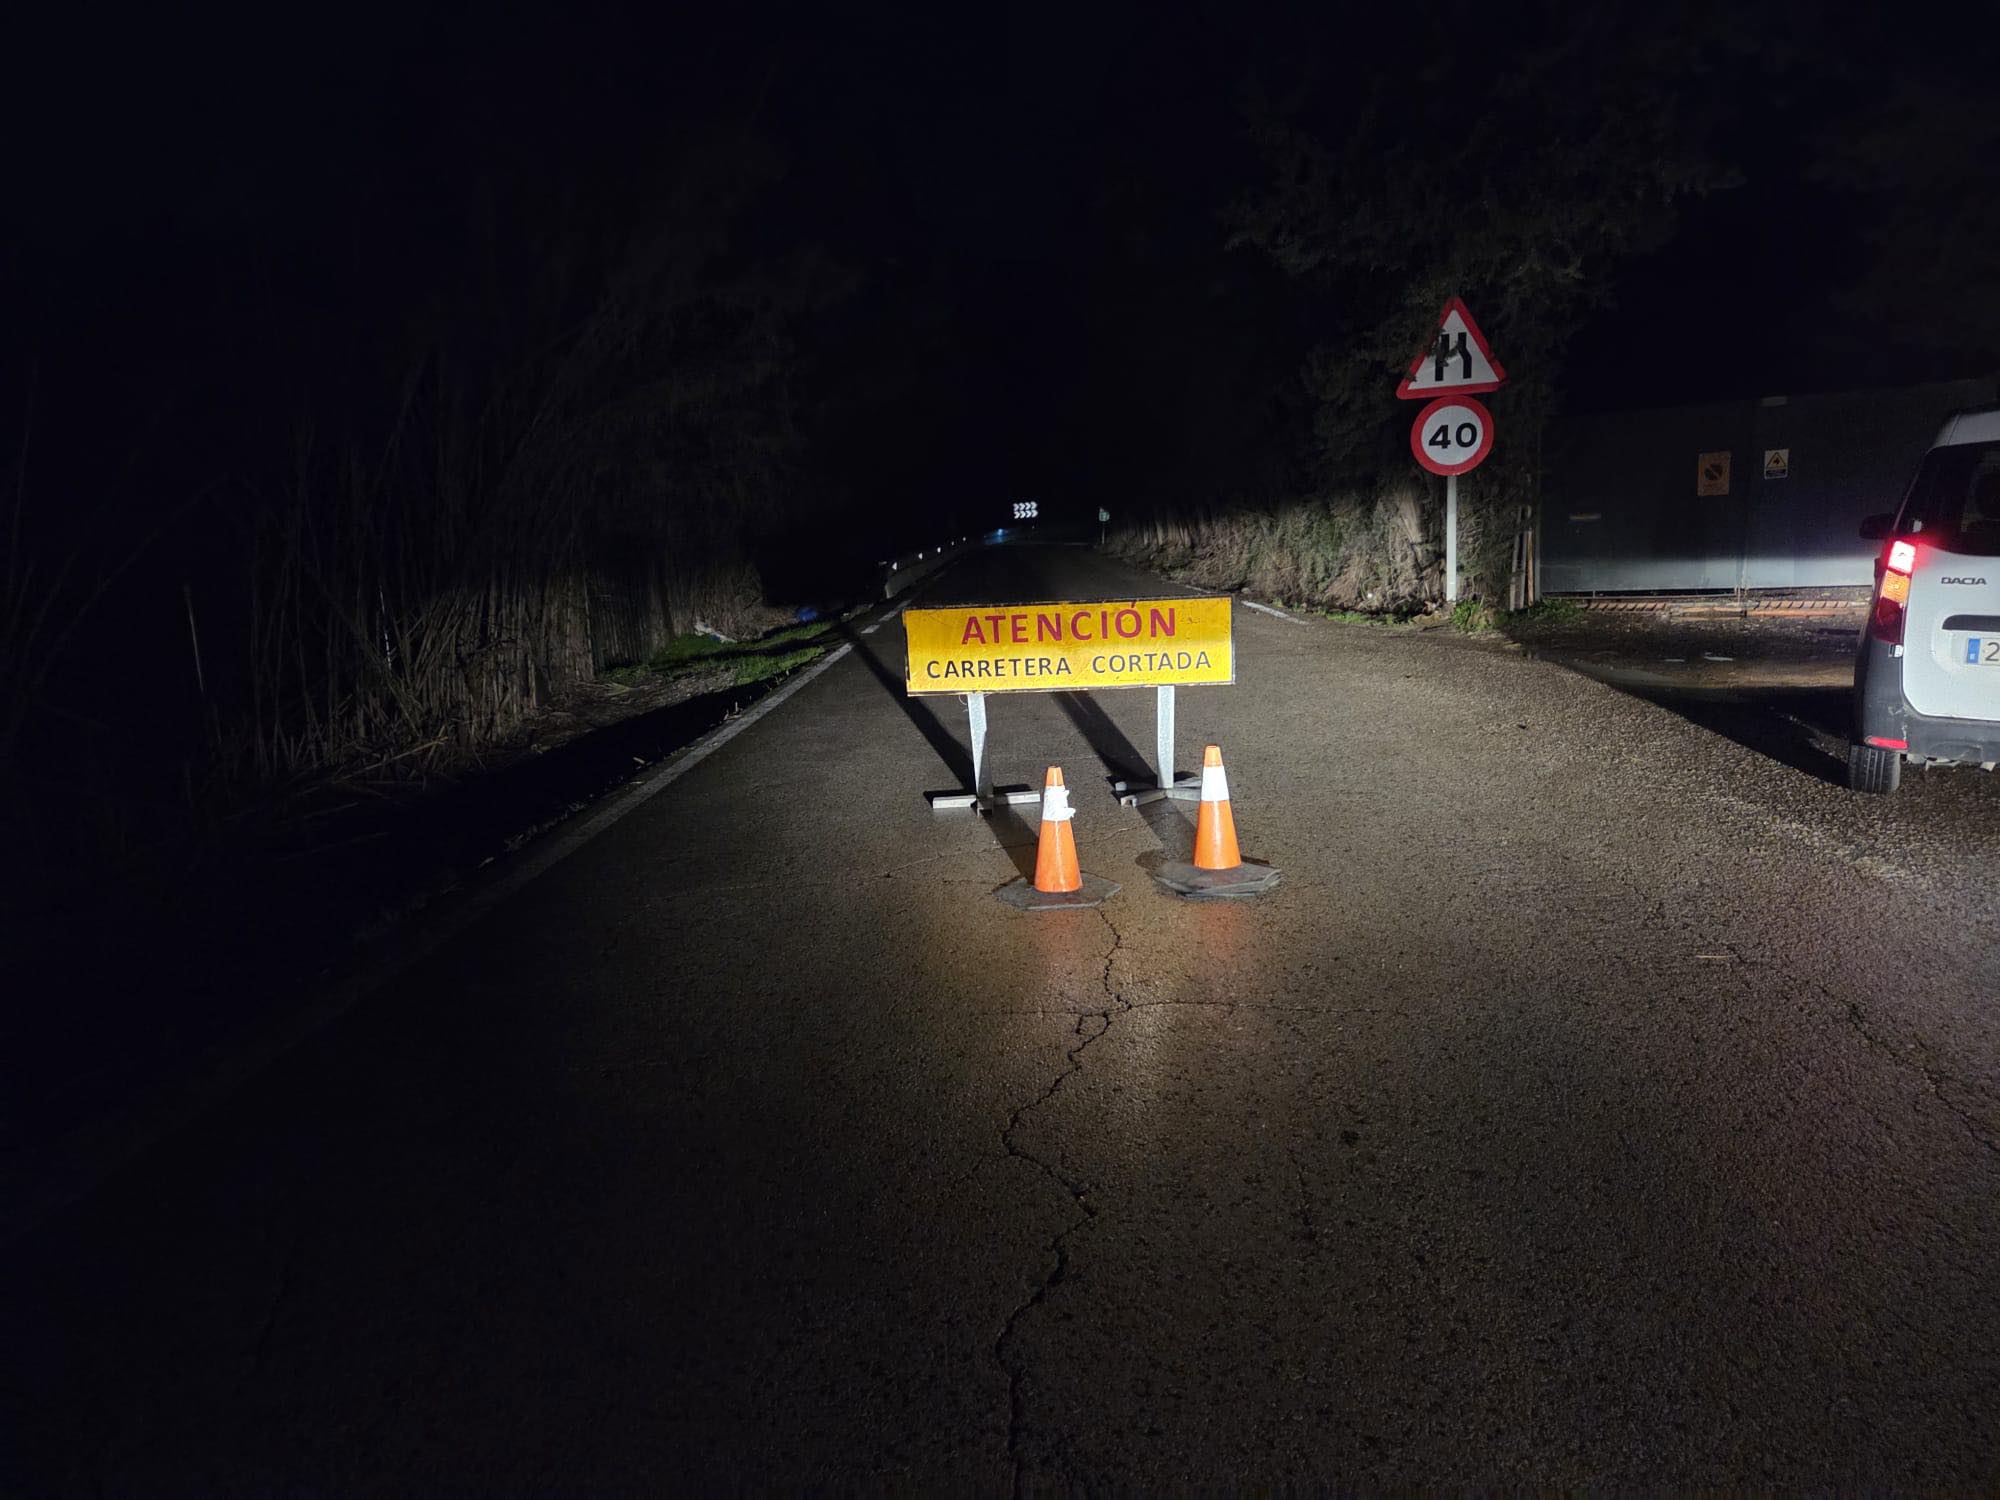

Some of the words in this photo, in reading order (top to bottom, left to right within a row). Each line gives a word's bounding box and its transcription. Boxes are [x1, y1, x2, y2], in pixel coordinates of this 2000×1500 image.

[1428, 422, 1478, 449] 40
[1940, 576, 1987, 585] DACIA
[961, 601, 1176, 645] ATENCIÓN
[926, 657, 1071, 679] CARRETERA
[1092, 650, 1212, 674] CORTADA
[1984, 641, 2000, 662] 2
